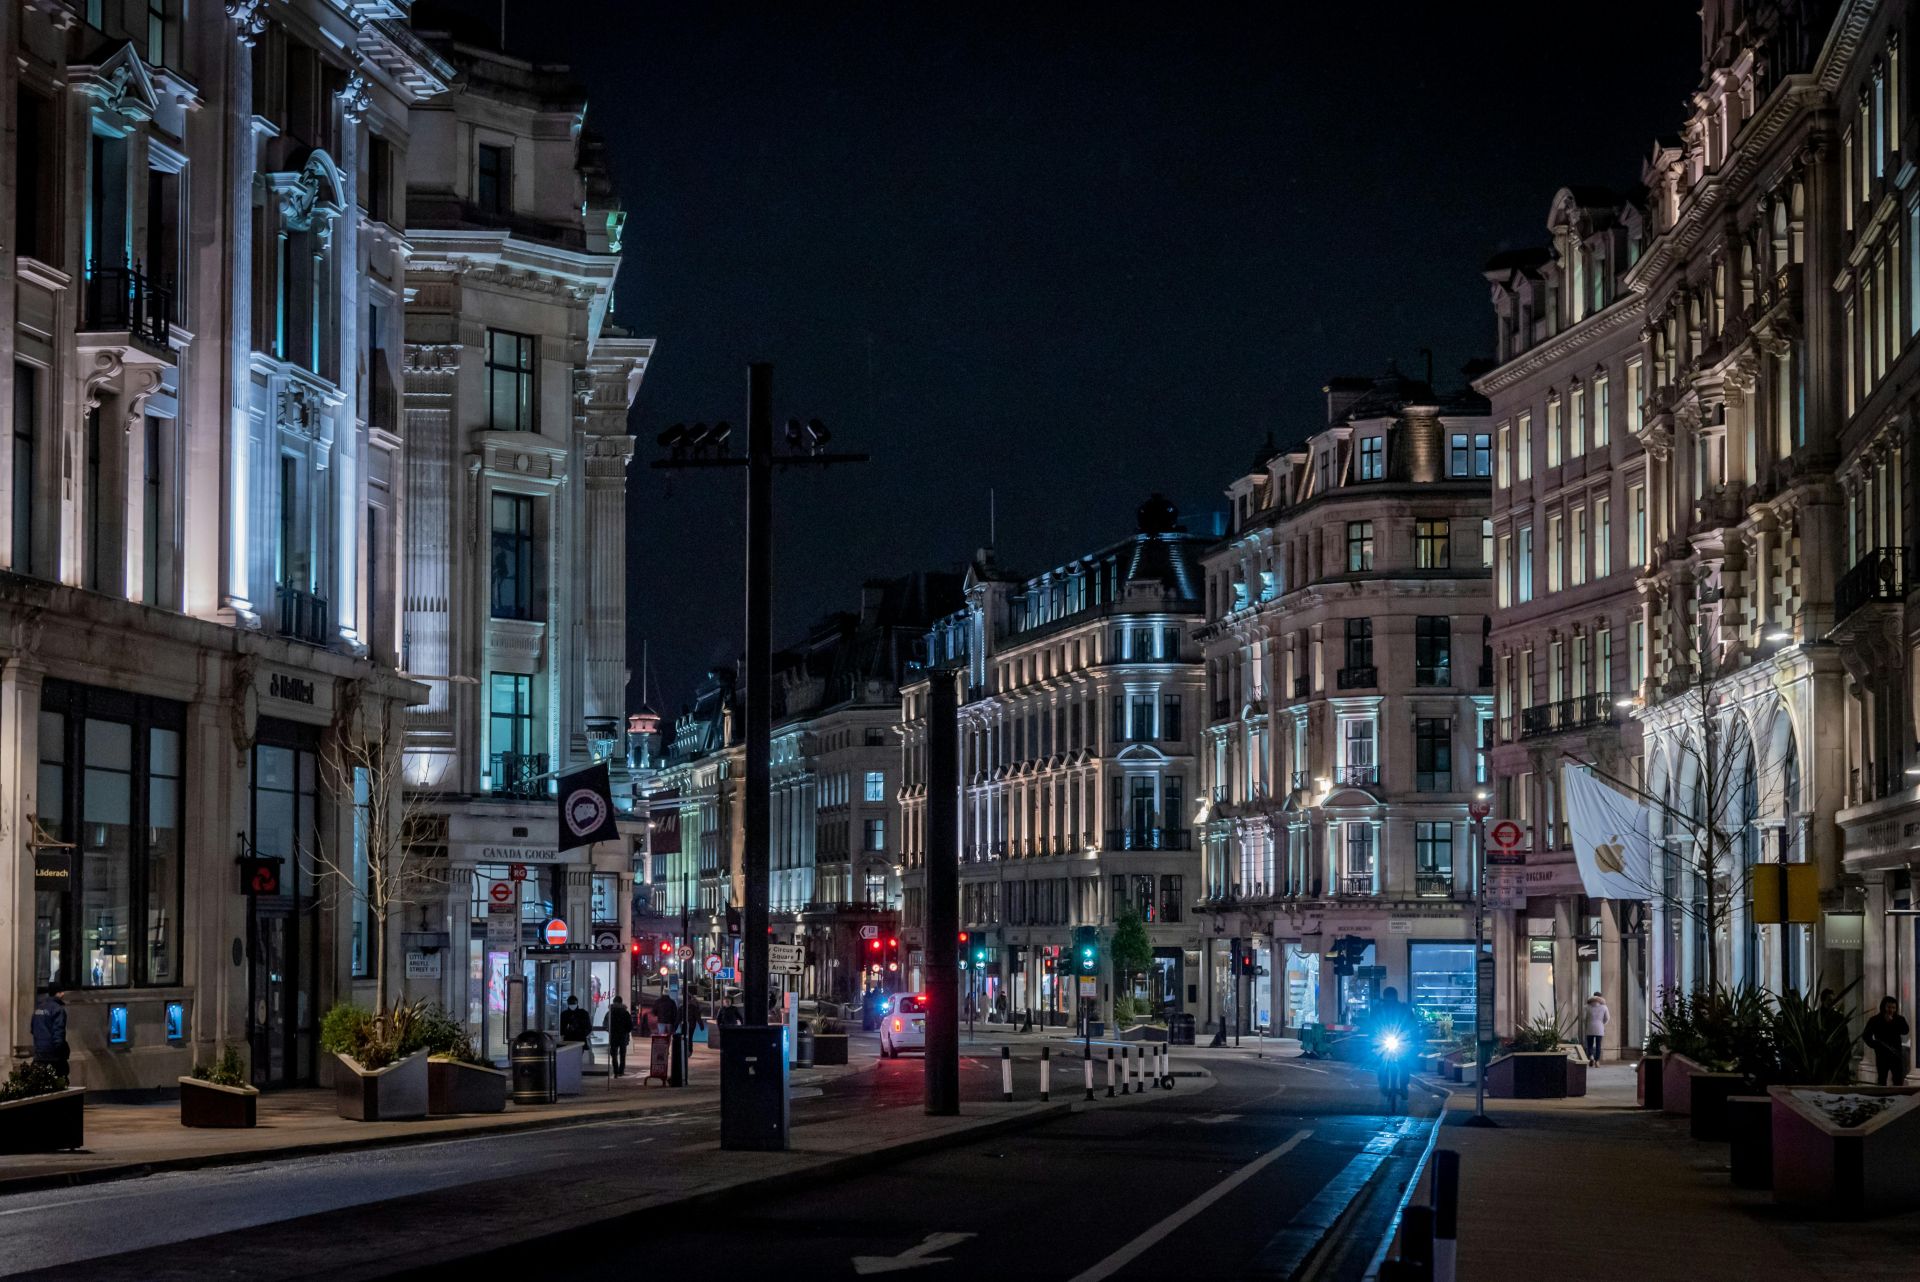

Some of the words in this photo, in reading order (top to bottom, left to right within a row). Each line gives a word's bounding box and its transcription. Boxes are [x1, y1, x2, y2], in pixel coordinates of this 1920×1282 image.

[281, 675, 314, 704] NatWest
[483, 847, 521, 859] CANADA
[525, 850, 557, 859] GOOSE
[35, 868, 69, 877] Läderach
[680, 949, 692, 957] 20
